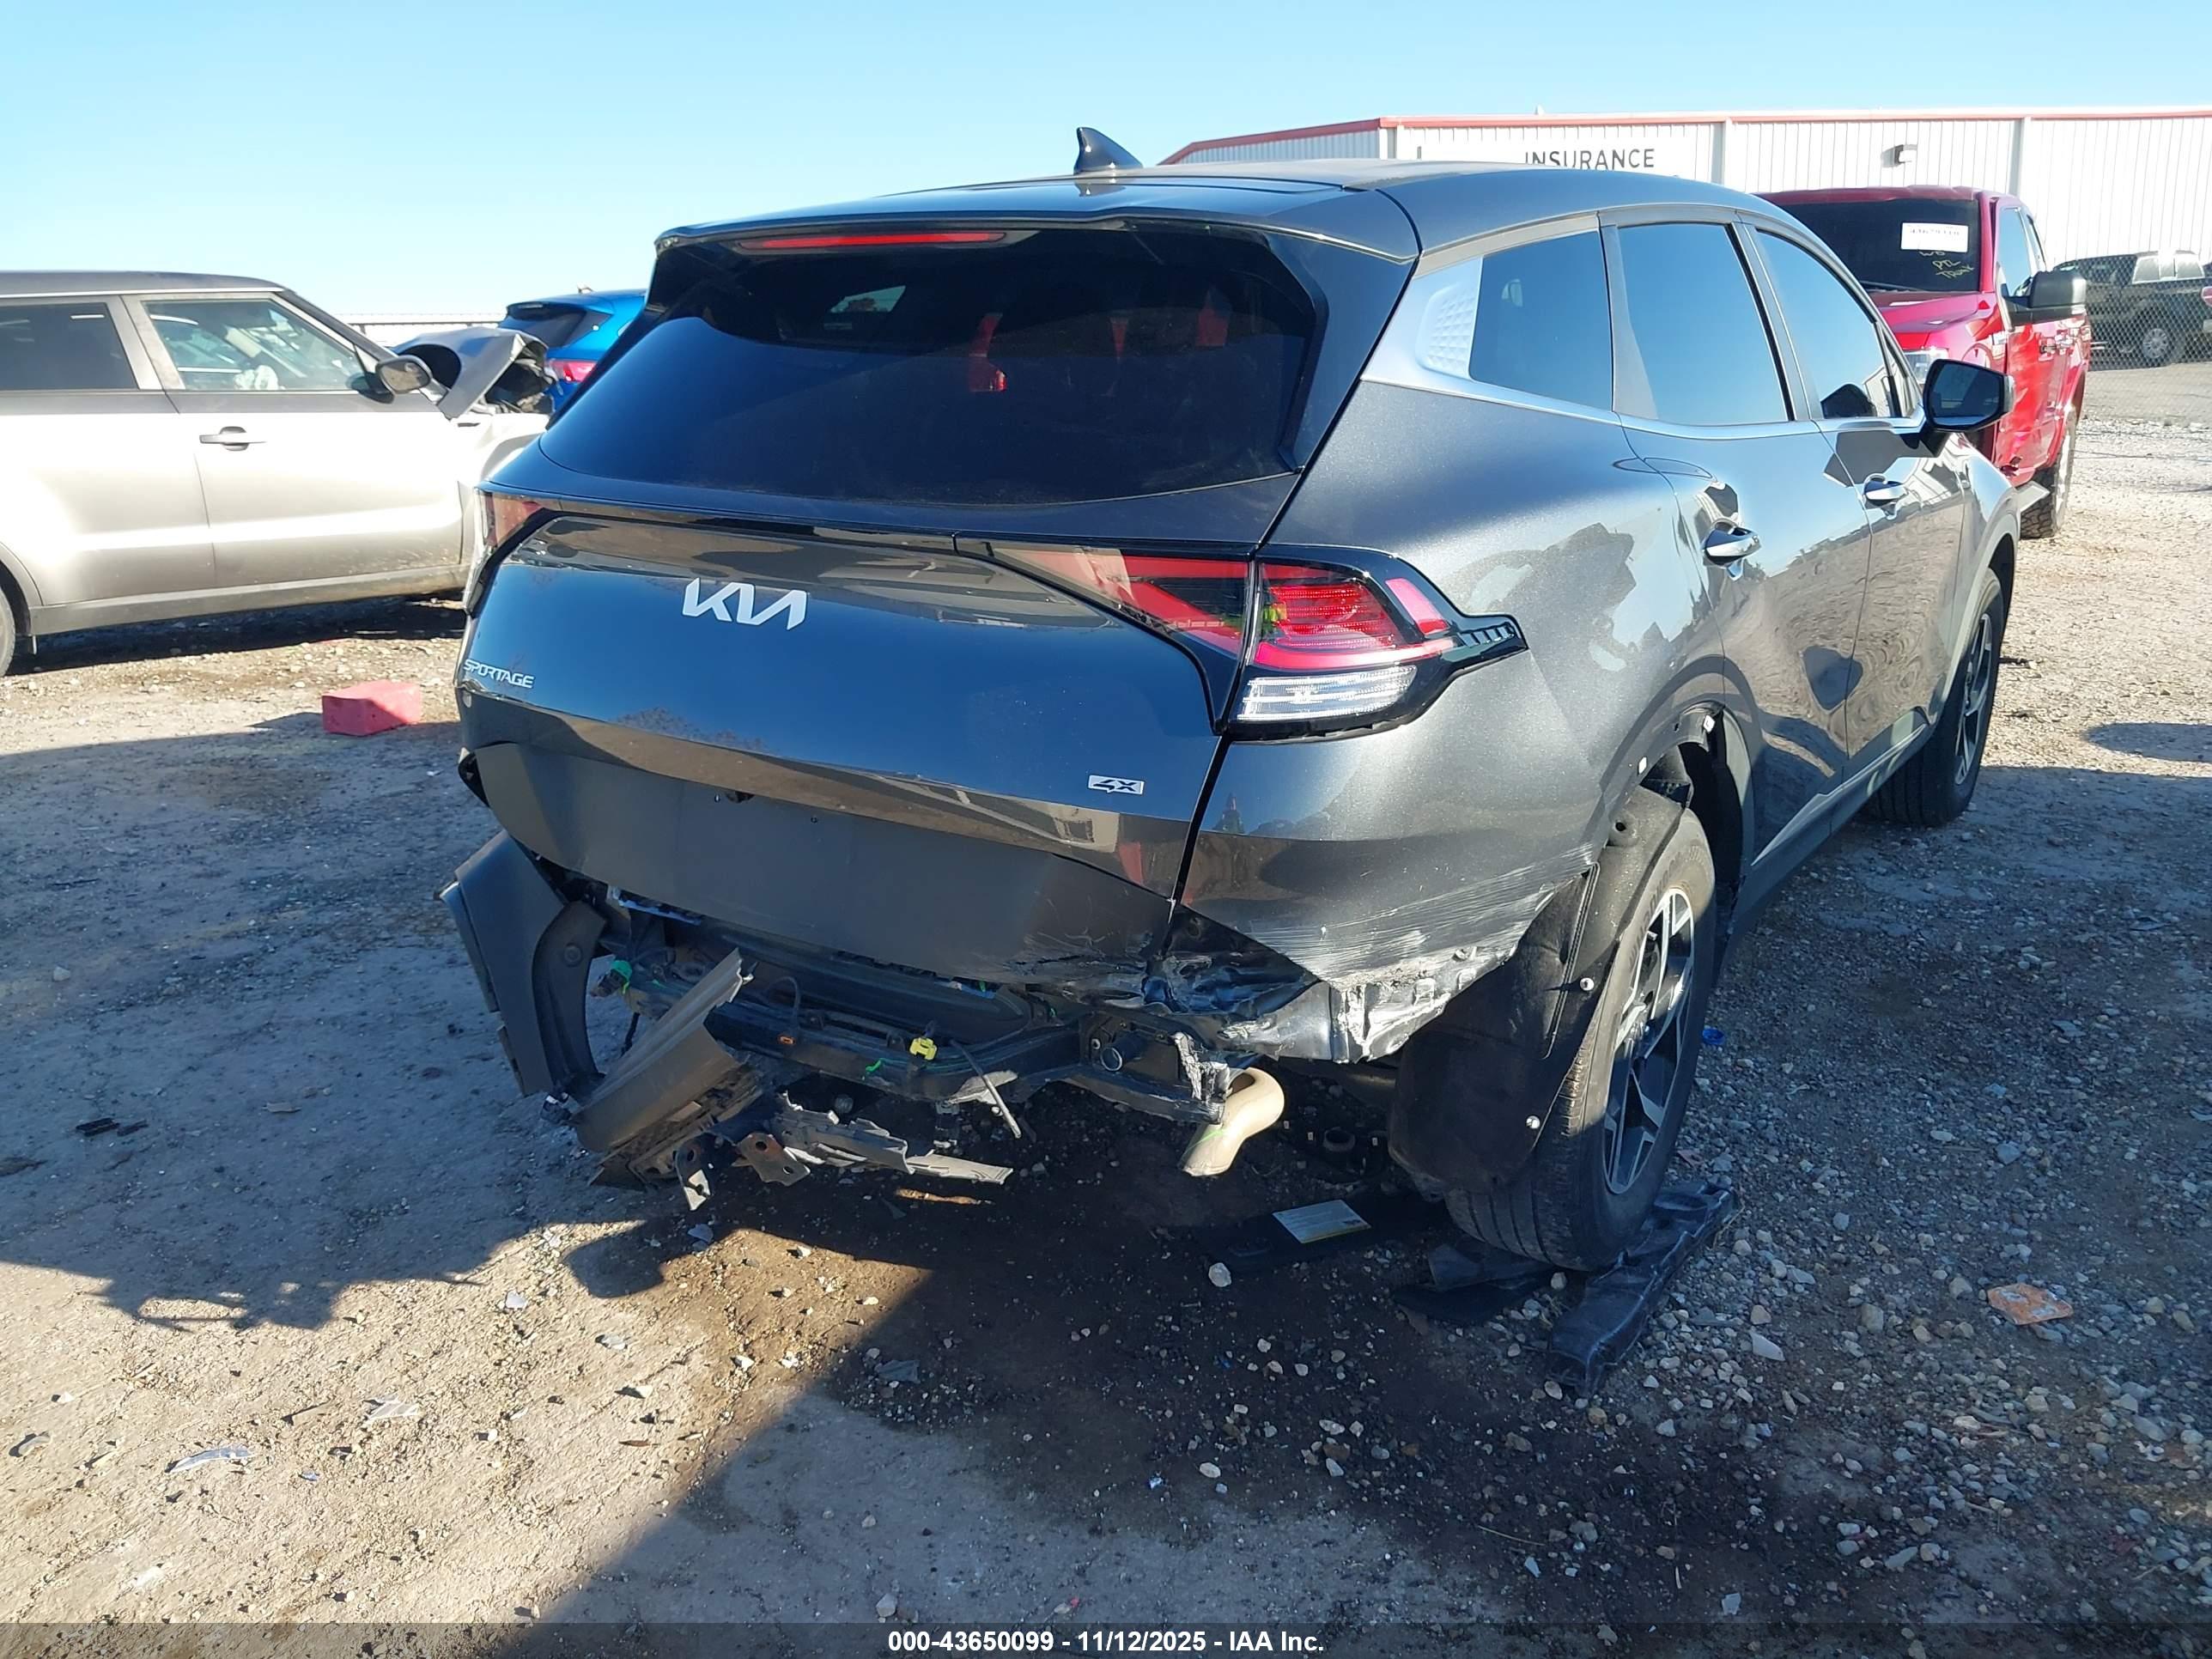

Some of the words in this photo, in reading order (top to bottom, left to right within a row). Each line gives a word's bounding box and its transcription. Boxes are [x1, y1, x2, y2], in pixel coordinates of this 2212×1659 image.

[1525, 149, 1655, 171] INSURANCE
[683, 577, 807, 630] KIA
[464, 659, 534, 689] SPORTAGE
